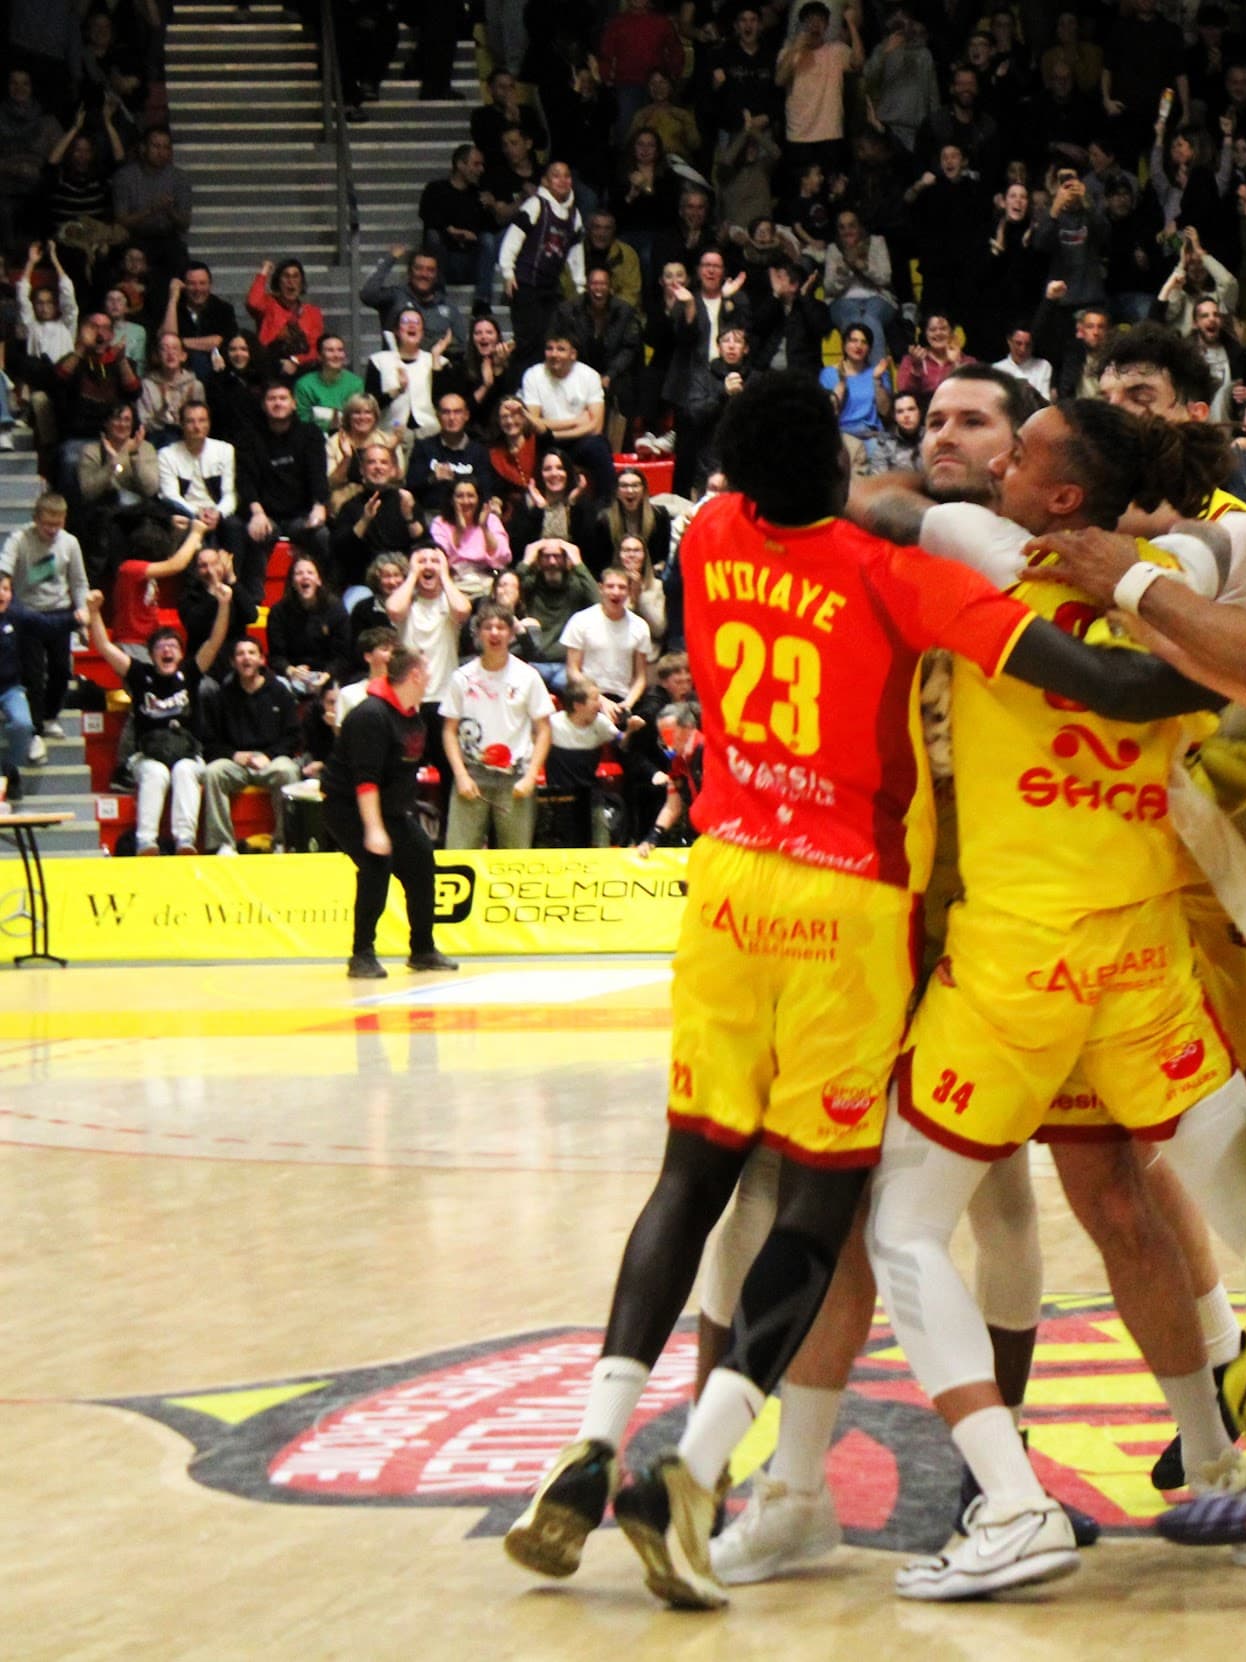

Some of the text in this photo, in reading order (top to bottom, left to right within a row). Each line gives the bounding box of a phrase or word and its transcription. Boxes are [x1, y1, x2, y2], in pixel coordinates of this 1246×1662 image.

[704, 561, 847, 633] N'DIAYE
[714, 621, 821, 756] 23
[488, 880, 687, 899] DELMONIC
[153, 904, 187, 926] de
[484, 905, 623, 923] DOREL
[932, 1068, 976, 1115] 34
